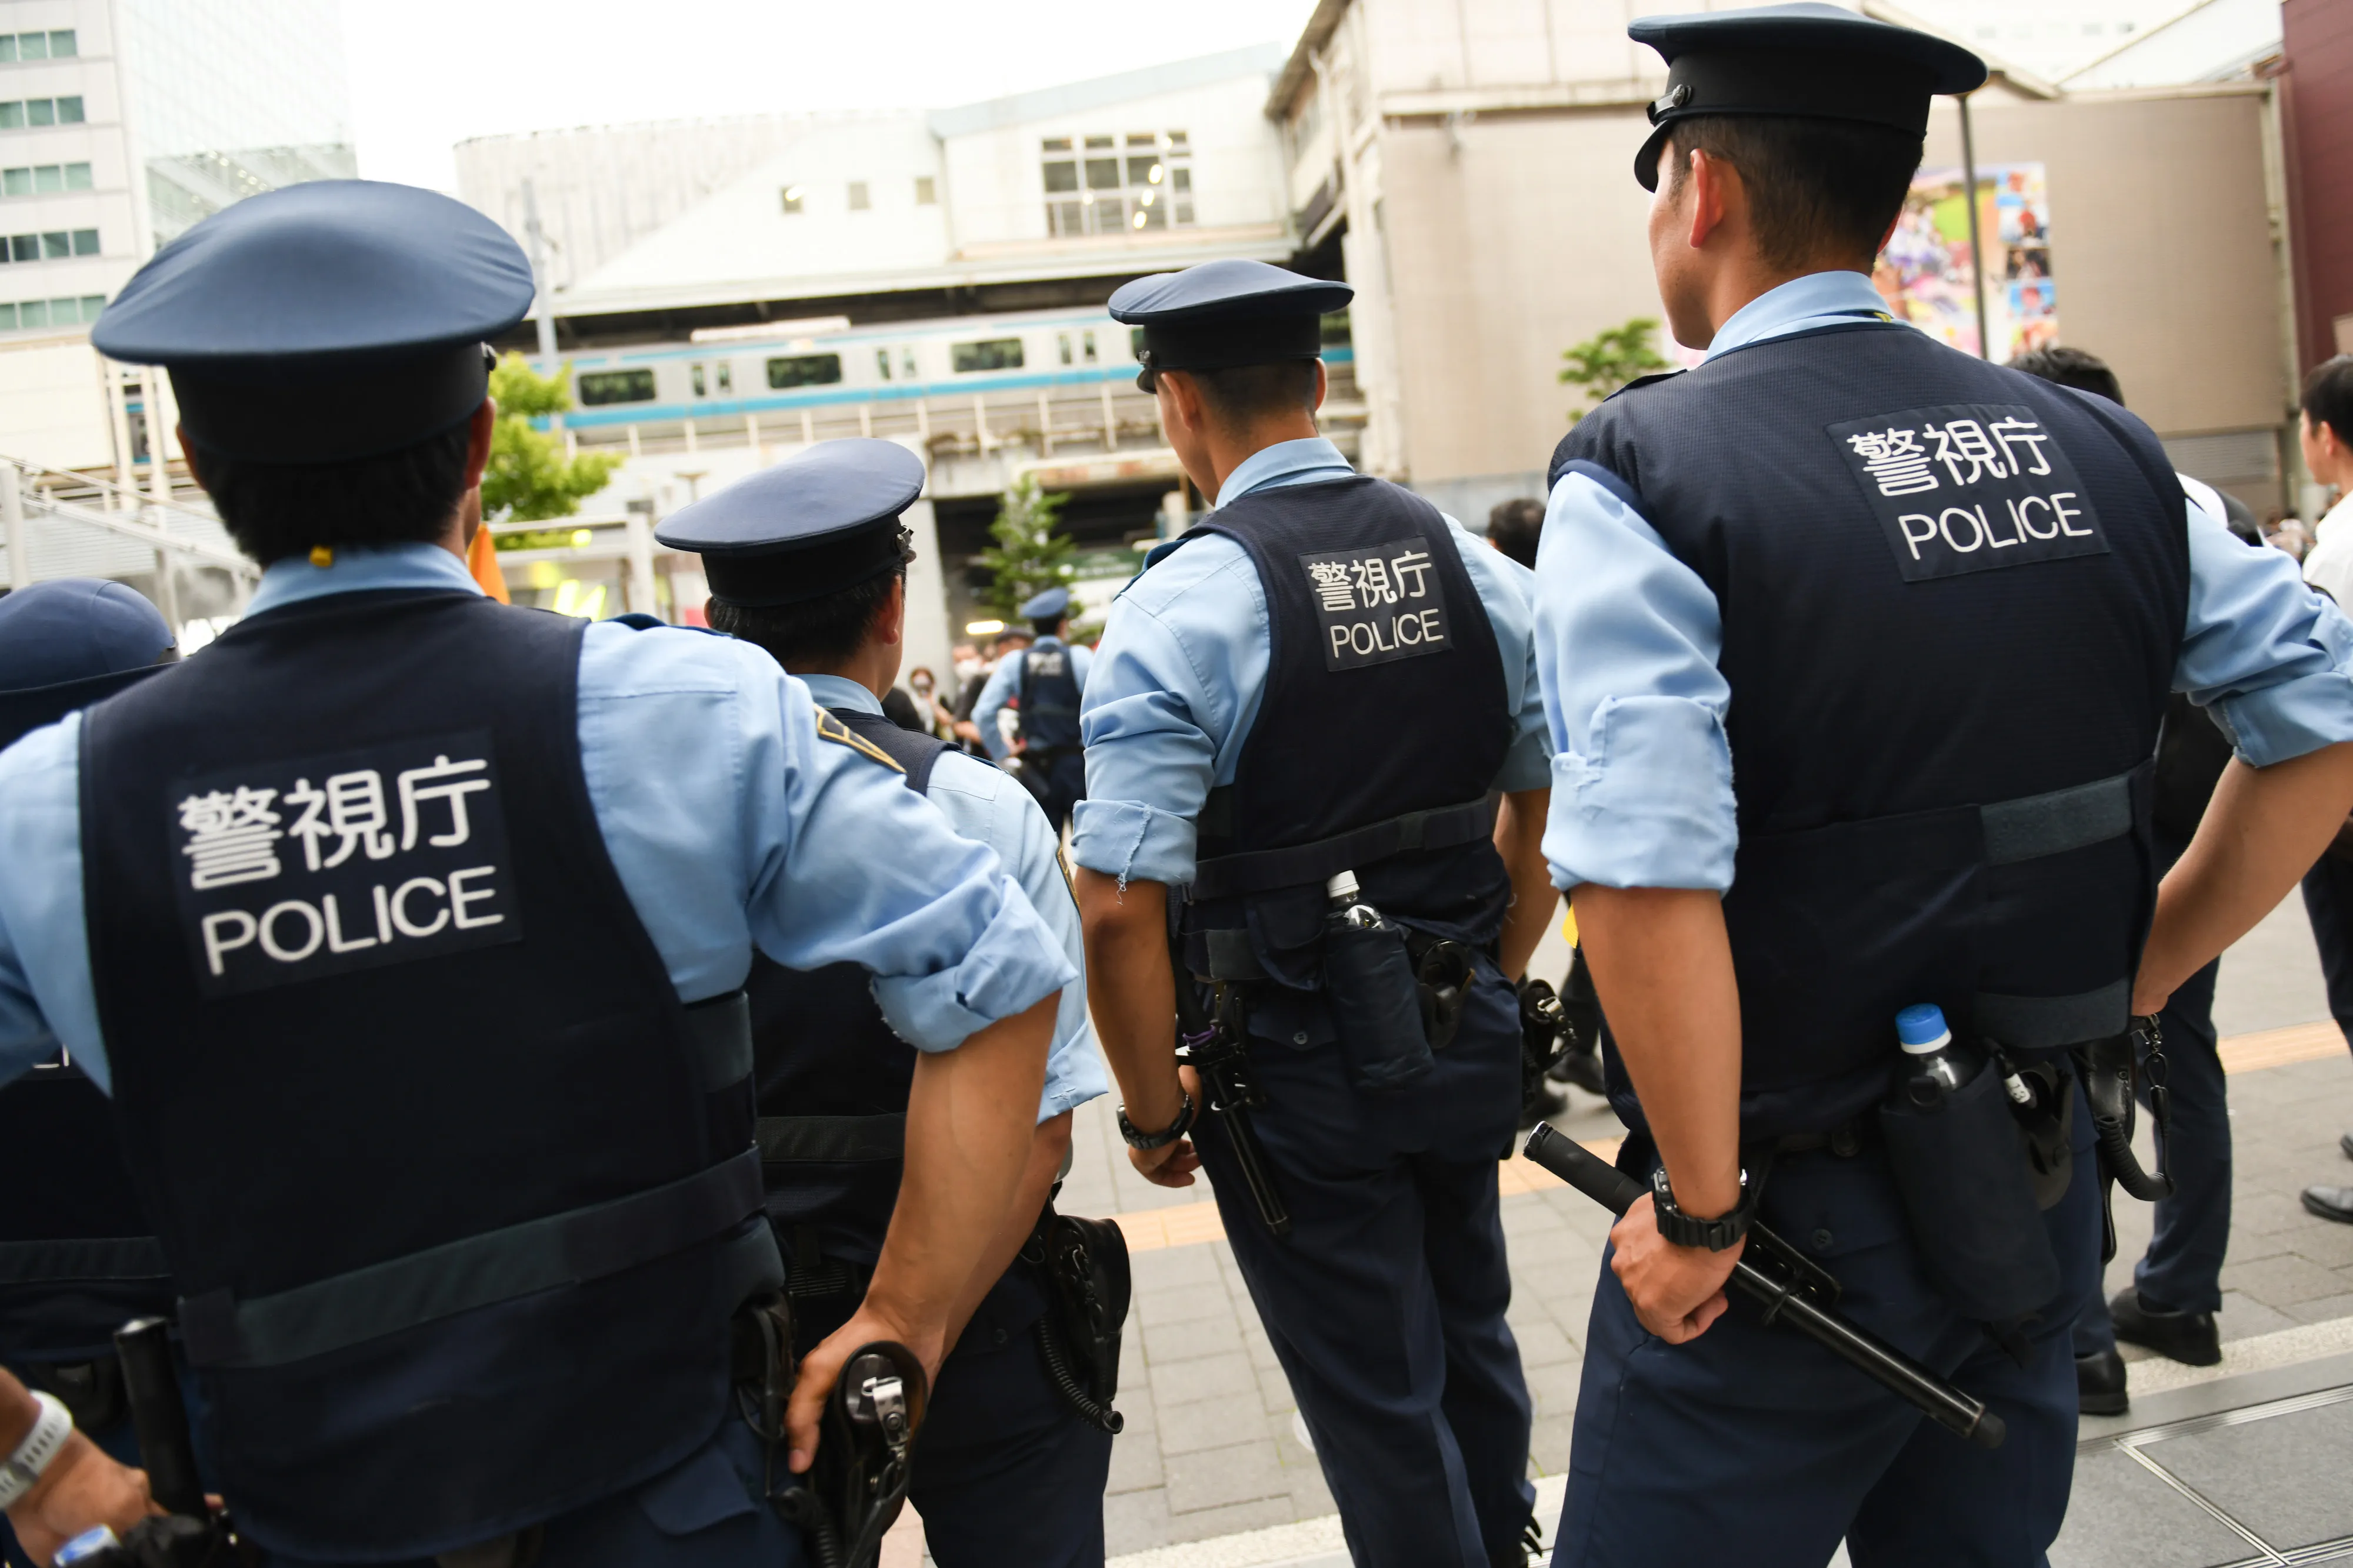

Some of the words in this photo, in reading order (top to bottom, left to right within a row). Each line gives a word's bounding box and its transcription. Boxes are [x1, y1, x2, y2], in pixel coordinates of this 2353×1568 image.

[1847, 416, 2051, 496] 警視庁
[1898, 493, 2092, 560] POLICE
[1308, 551, 1432, 611] 警視庁
[1331, 609, 1444, 658] POLICE
[178, 755, 491, 890] 警視庁
[202, 866, 504, 975] POLICE
